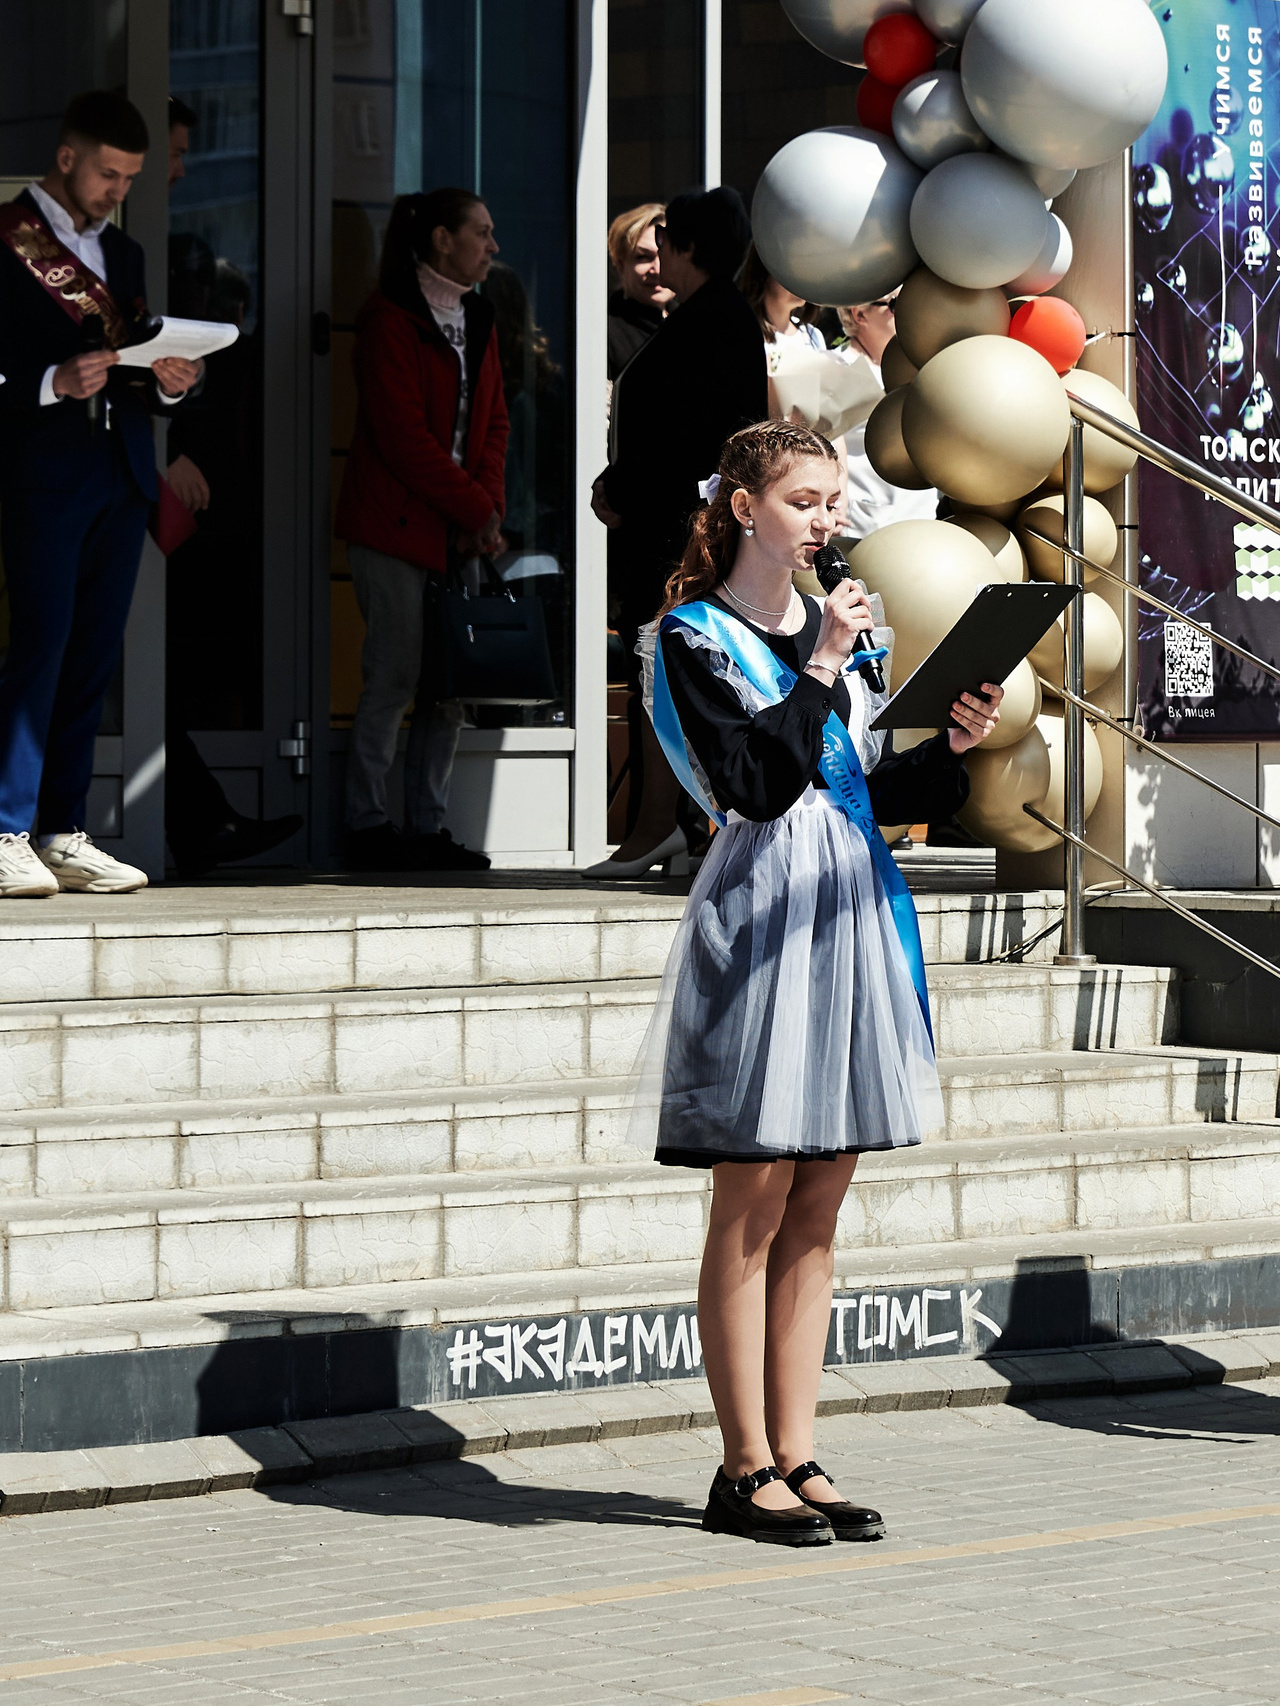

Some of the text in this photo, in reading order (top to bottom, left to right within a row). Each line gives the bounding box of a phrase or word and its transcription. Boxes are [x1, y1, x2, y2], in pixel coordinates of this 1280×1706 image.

[1211, 23, 1232, 159] Учимся
[1244, 26, 1263, 266] Развиваемся
[1167, 705, 1216, 719] Вк лицея
